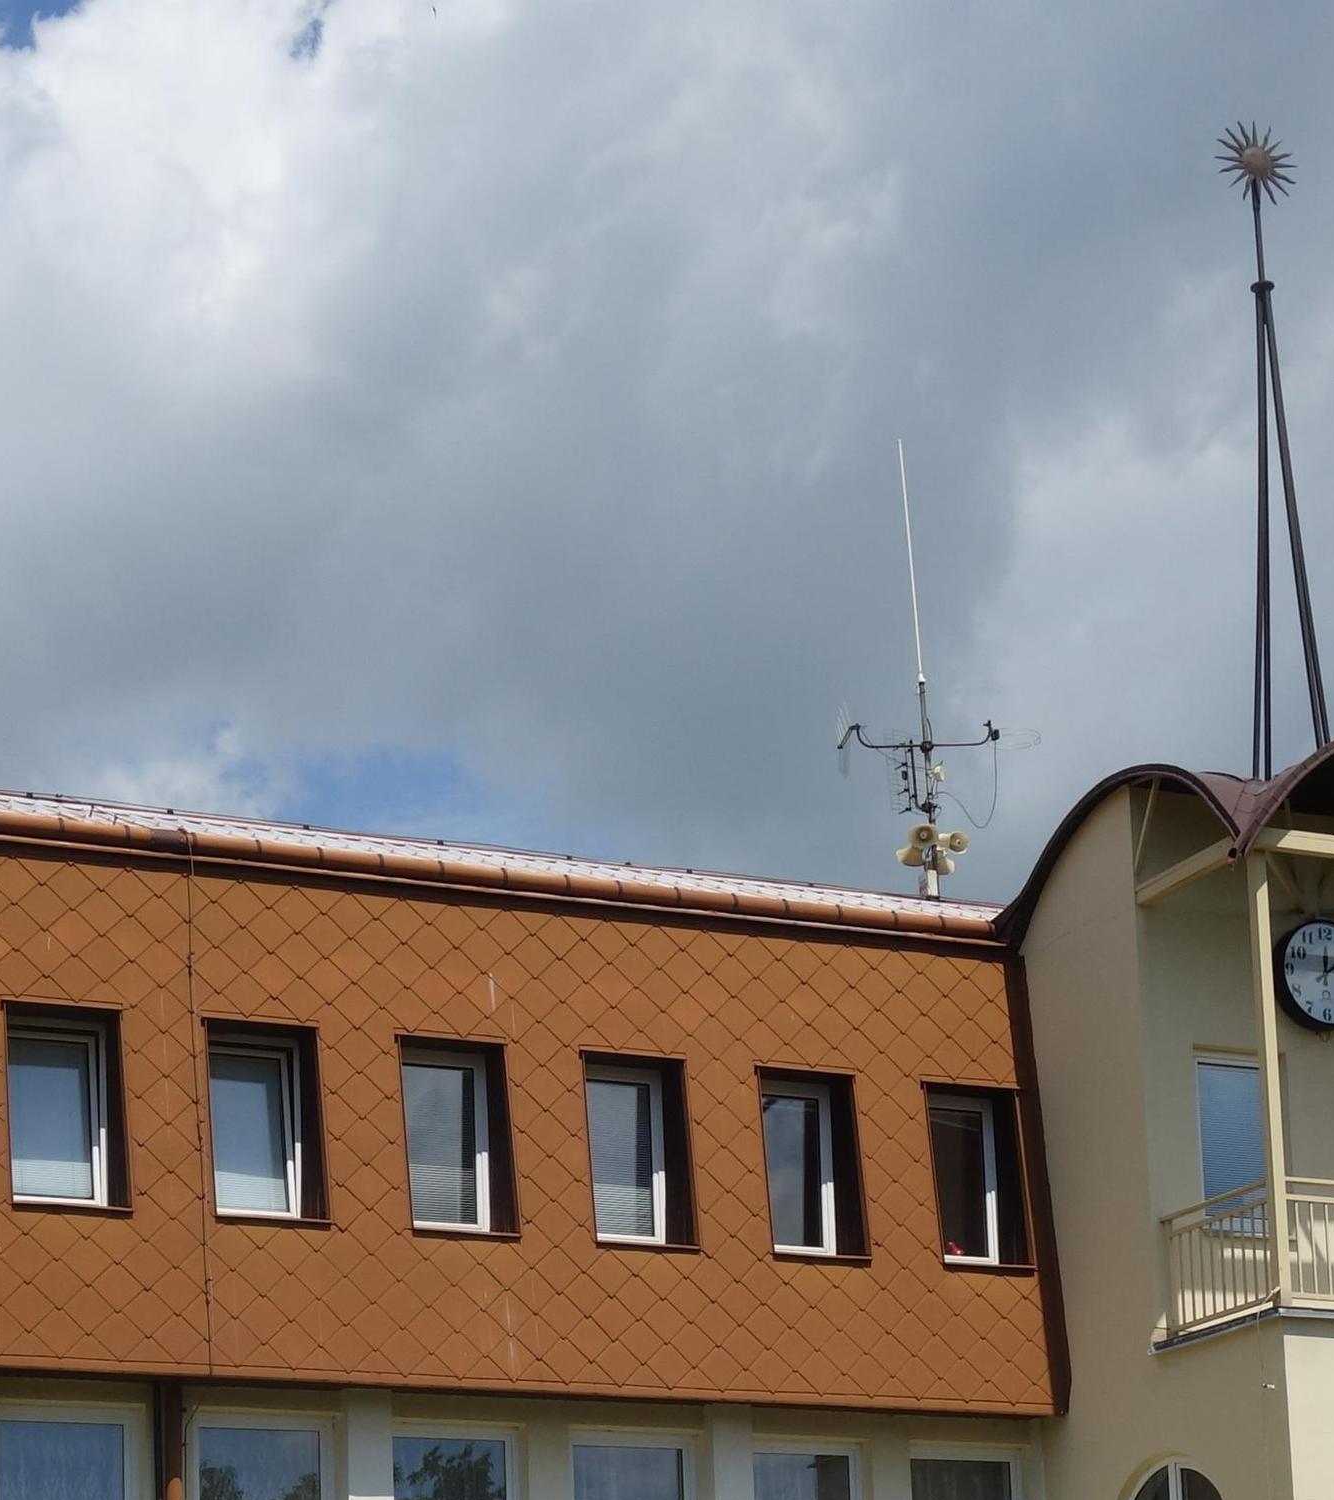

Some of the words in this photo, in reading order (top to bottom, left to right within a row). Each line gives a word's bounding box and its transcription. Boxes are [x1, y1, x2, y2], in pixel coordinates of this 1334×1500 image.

[1302, 930, 1313, 945] 11
[1318, 927, 1332, 941] 12
[1290, 946, 1306, 960] 10
[1285, 962, 1295, 976] 9
[1292, 983, 1302, 997] 8
[1305, 1001, 1313, 1014] 7
[1323, 1008, 1332, 1021] 6
